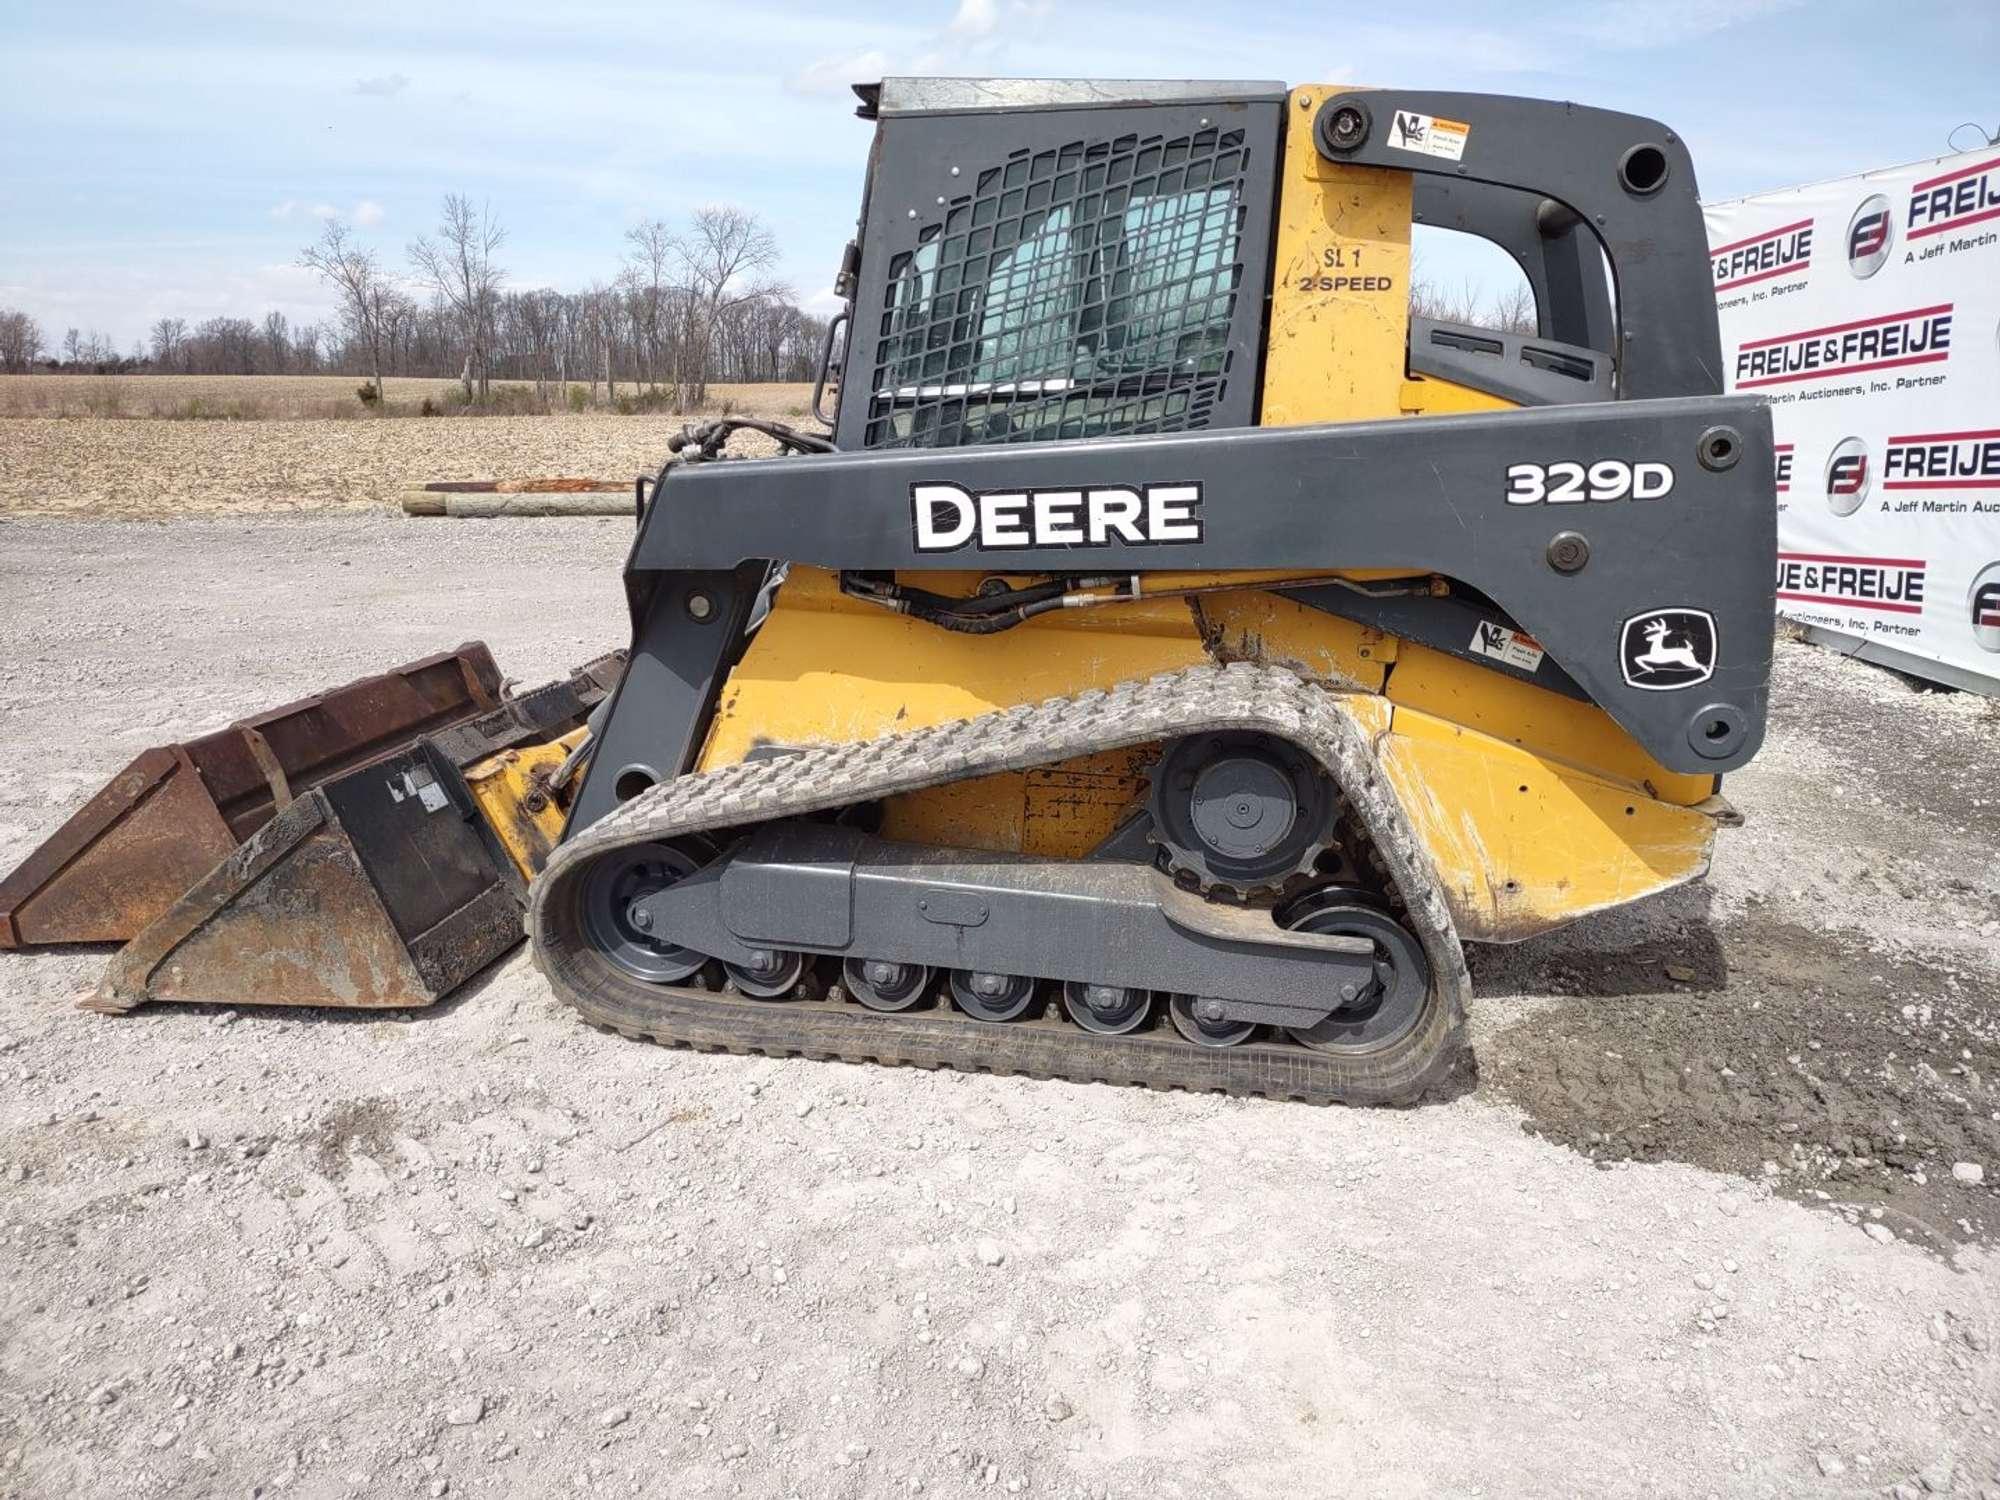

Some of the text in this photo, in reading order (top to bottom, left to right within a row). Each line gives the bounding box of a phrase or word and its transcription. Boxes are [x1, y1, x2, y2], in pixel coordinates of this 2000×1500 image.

[1323, 248, 1345, 268] SL
[1904, 231, 1998, 264] A Jeff Martin
[1298, 276, 1393, 292] 2-SPEED
[1752, 291, 1768, 303] Inc.
[1771, 280, 1808, 297] Partner
[1798, 383, 1866, 401] Auctioneers,
[1870, 381, 1892, 393] Inc.
[1896, 374, 1947, 390] Partner
[1506, 460, 1674, 505] 329D
[914, 485, 1200, 549] DEERE
[1880, 500, 1890, 513] A
[1894, 500, 1919, 513] Jeff
[1922, 500, 1967, 513] Martin
[1848, 617, 1869, 632] Inc.
[1873, 620, 1922, 637] Partner
